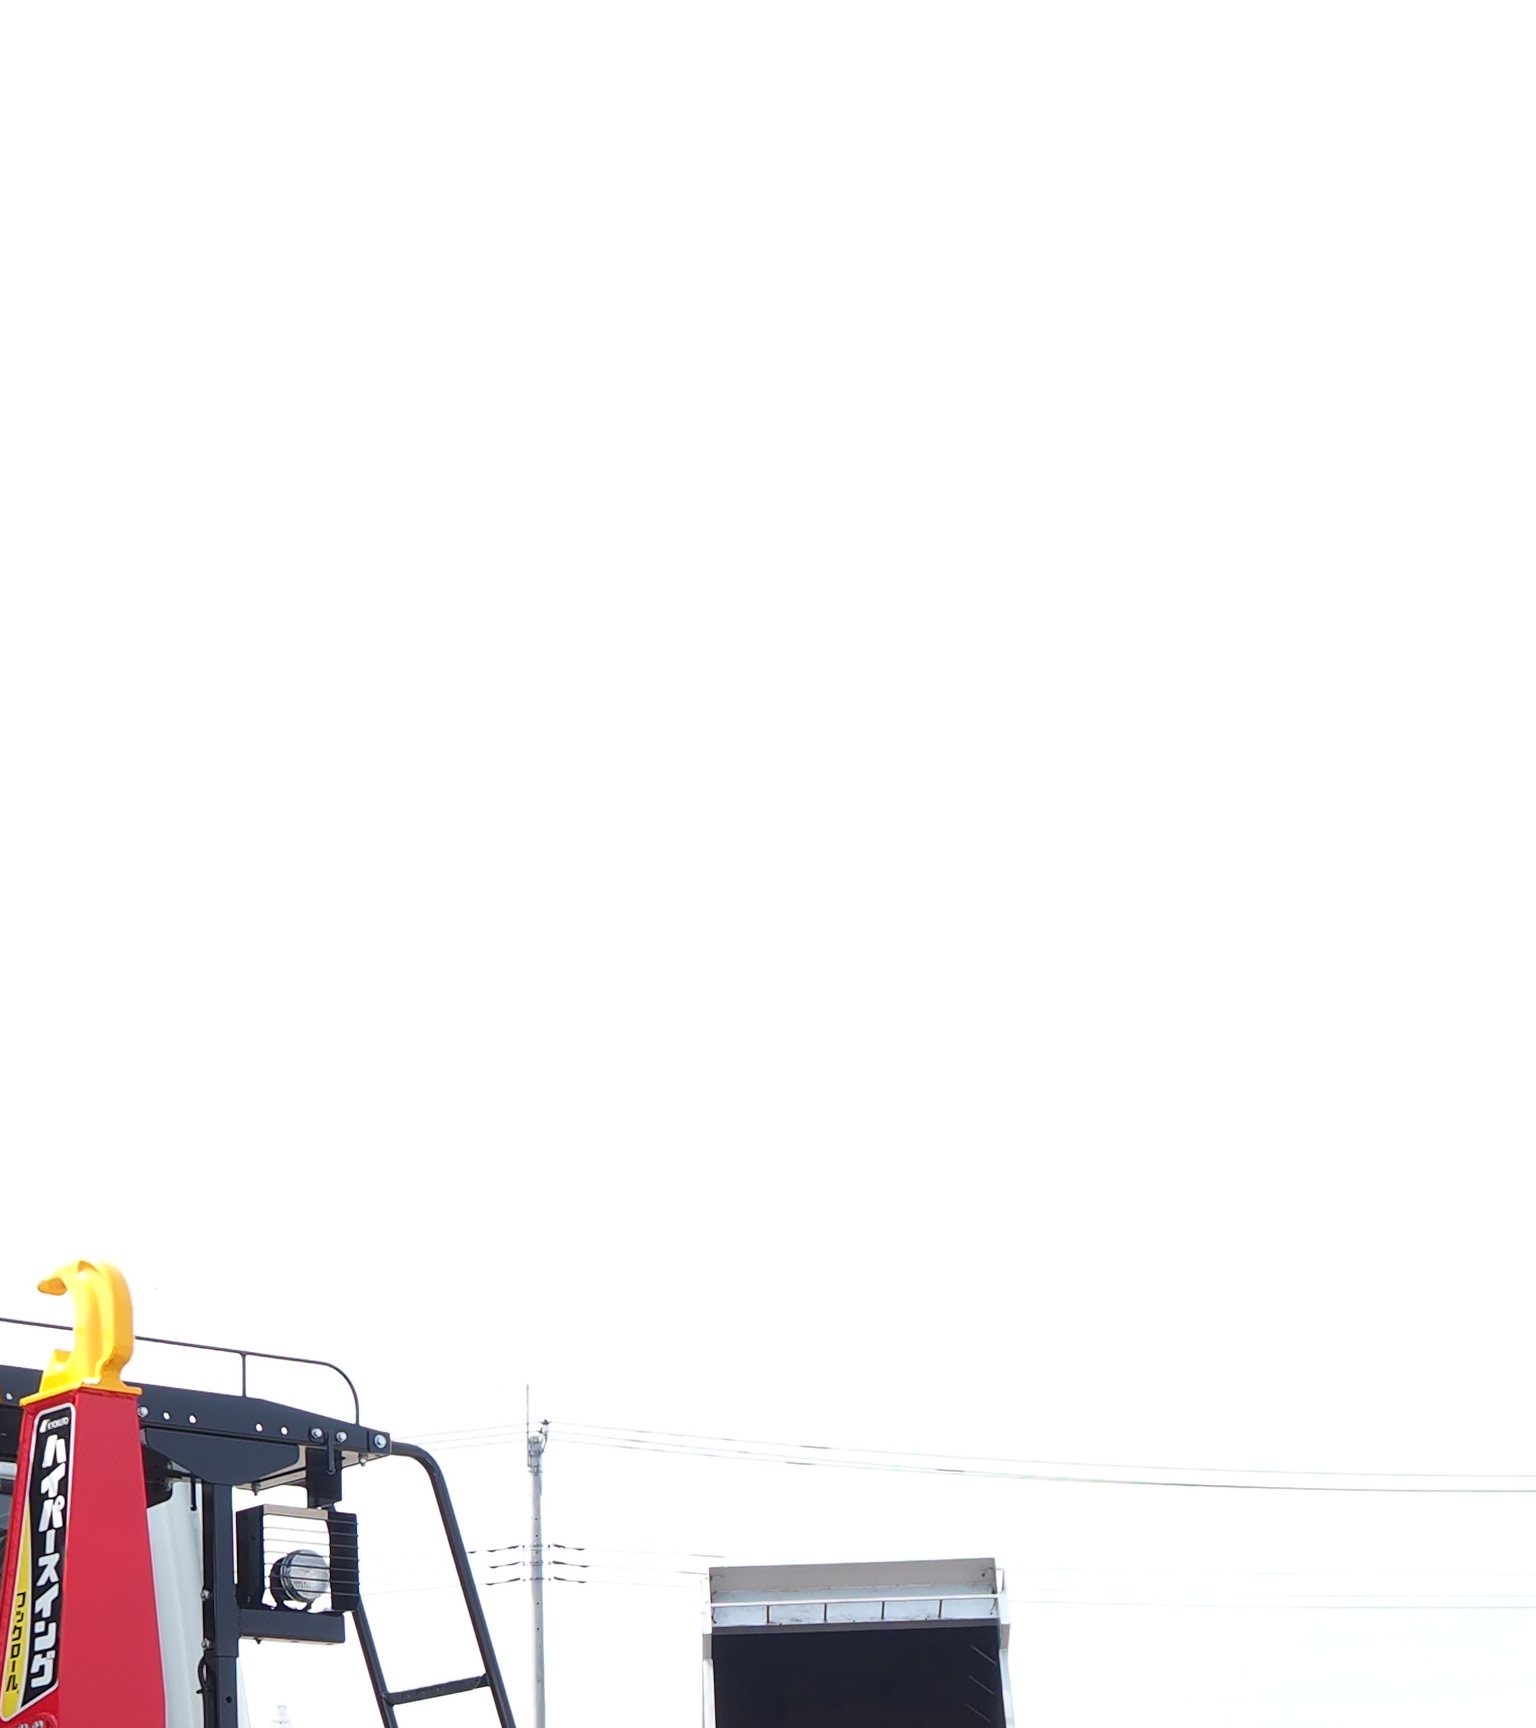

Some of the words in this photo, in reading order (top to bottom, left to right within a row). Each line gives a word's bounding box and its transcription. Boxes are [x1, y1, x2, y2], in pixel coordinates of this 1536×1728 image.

[6, 1591, 26, 1693] フックロール
[30, 1434, 67, 1688] ハイパースイング
